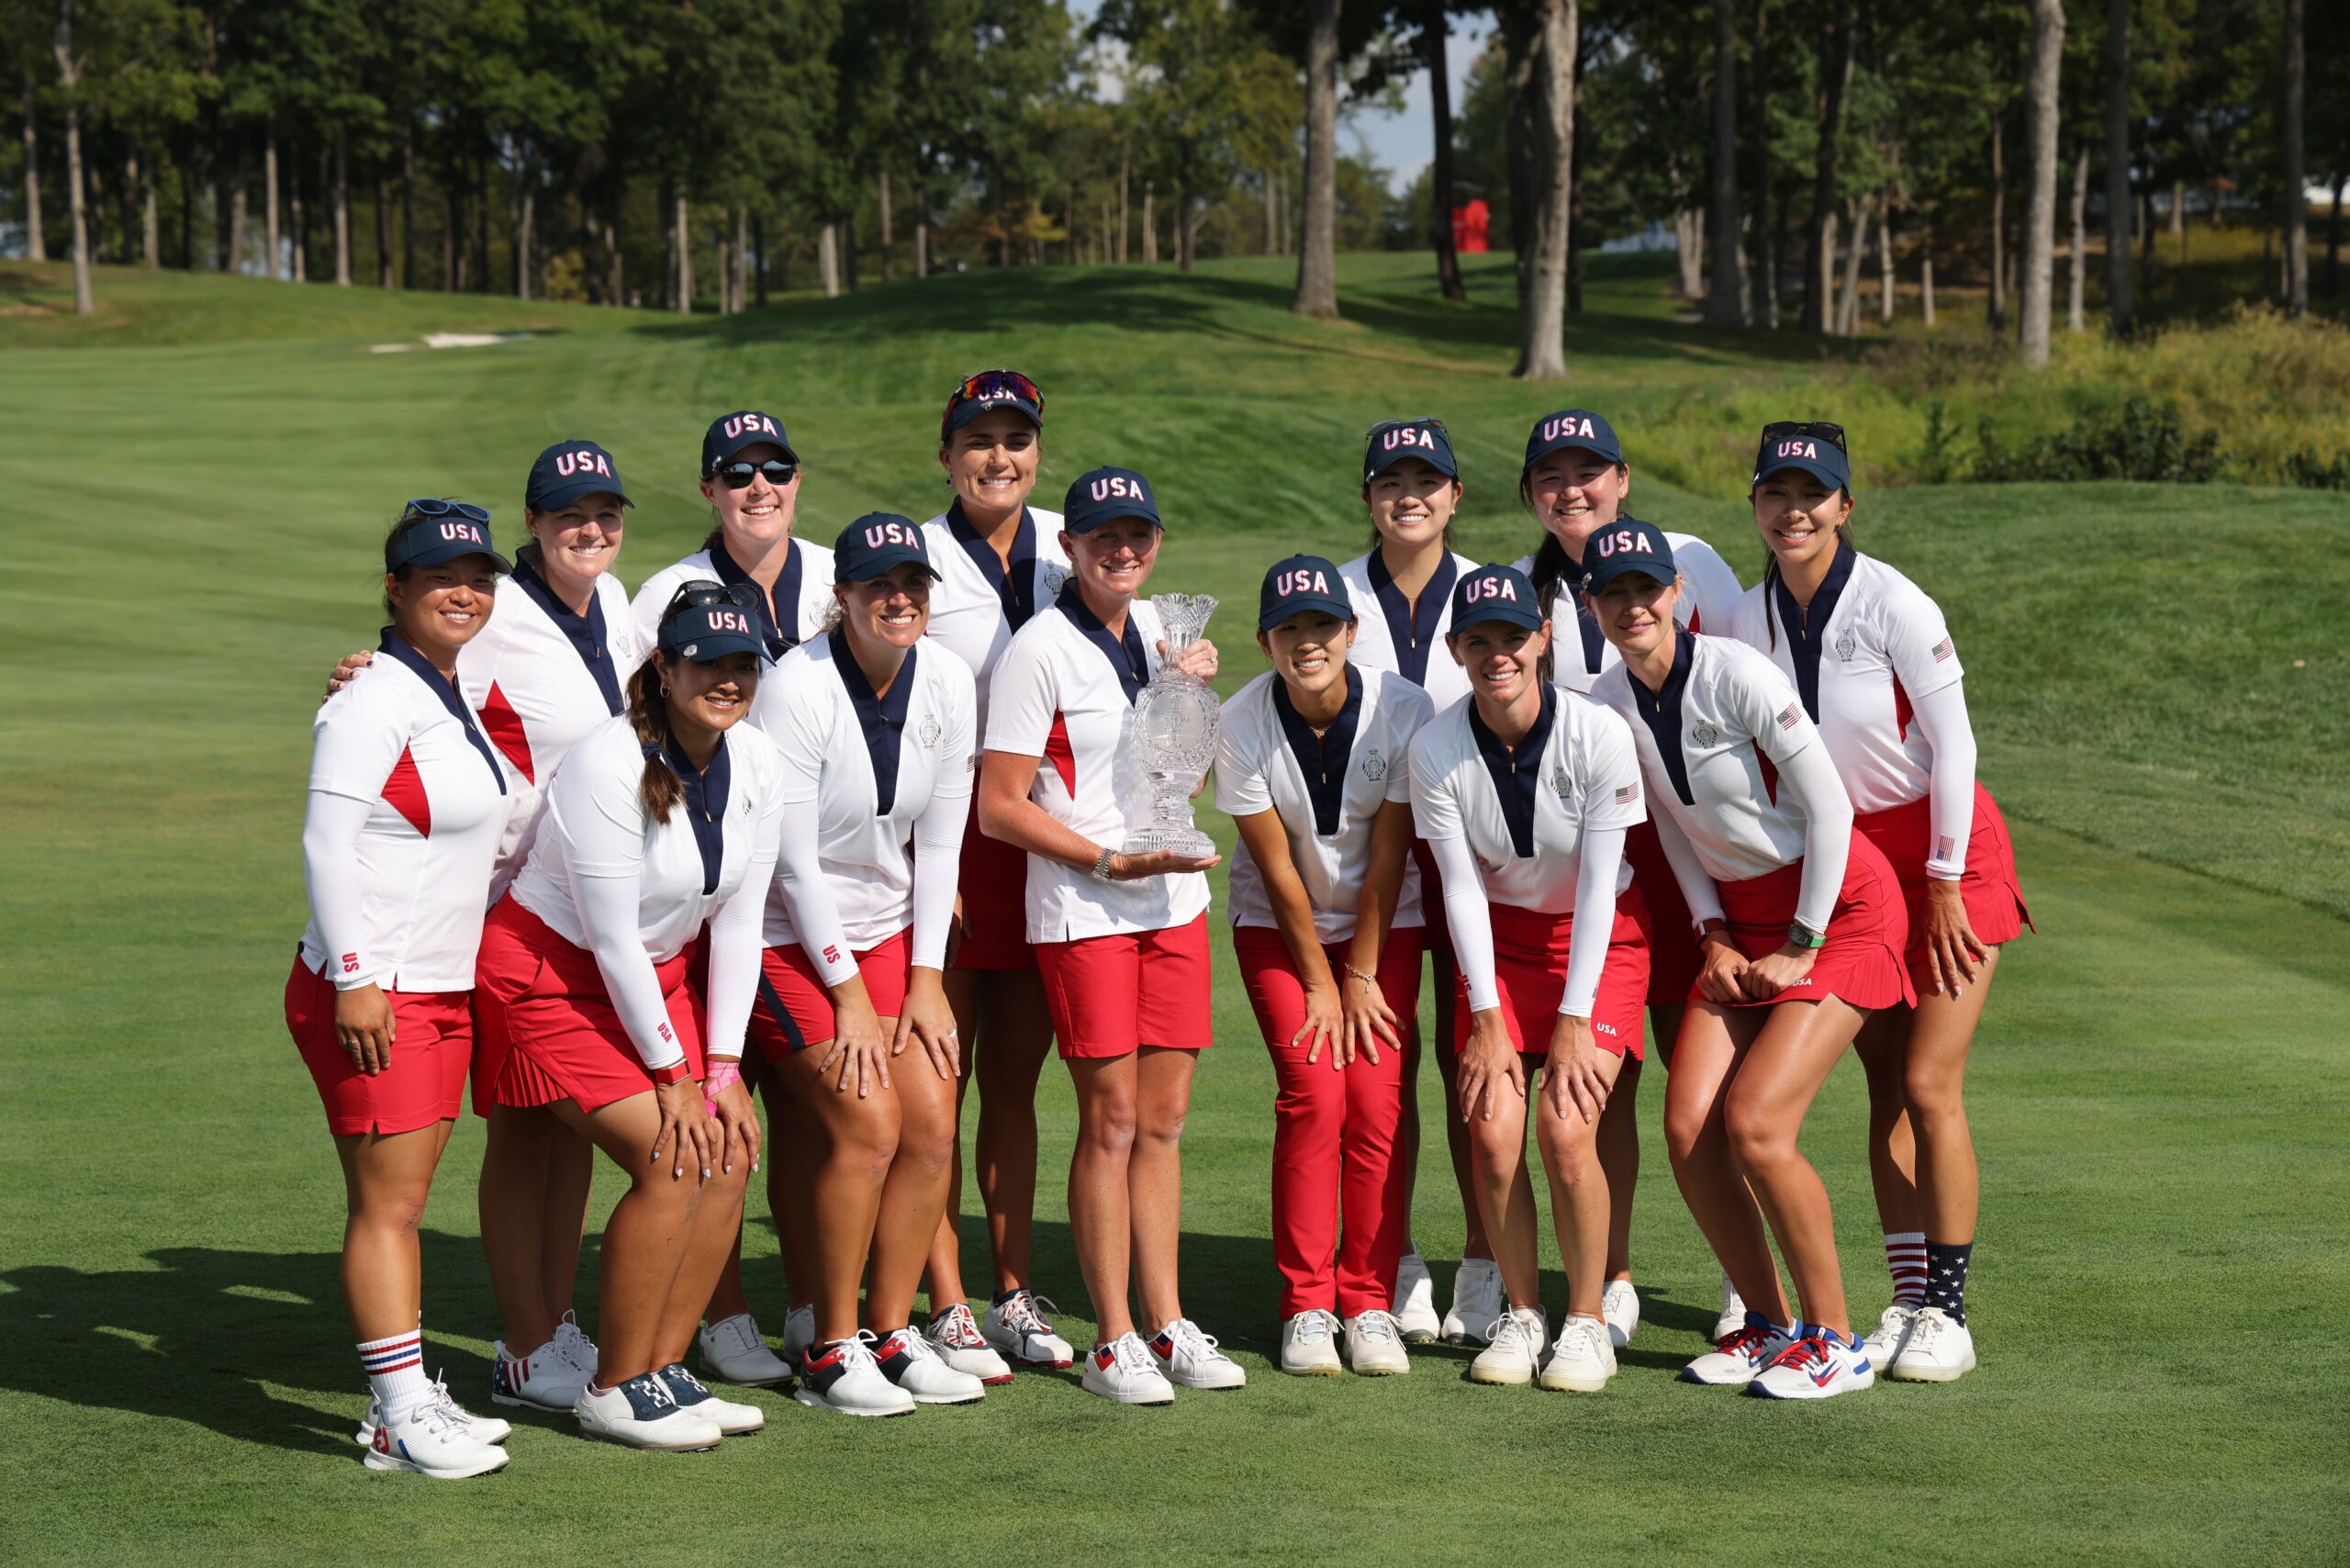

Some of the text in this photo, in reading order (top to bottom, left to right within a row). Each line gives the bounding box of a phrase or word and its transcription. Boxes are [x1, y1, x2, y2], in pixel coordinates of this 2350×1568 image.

[723, 413, 778, 439] USA
[1544, 417, 1595, 442] USA
[1383, 428, 1436, 451] USA
[1777, 441, 1817, 459] USA
[555, 450, 612, 478] USA
[1091, 476, 1146, 502] USA
[440, 522, 483, 545] USA
[865, 522, 920, 550] USA
[1598, 530, 1653, 557] USA
[1277, 569, 1330, 597] USA
[1466, 577, 1517, 604] USA
[708, 611, 750, 634] USA
[341, 951, 360, 973] US
[822, 944, 841, 965] US
[657, 1022, 673, 1043] USA
[1596, 1022, 1617, 1036] USA
